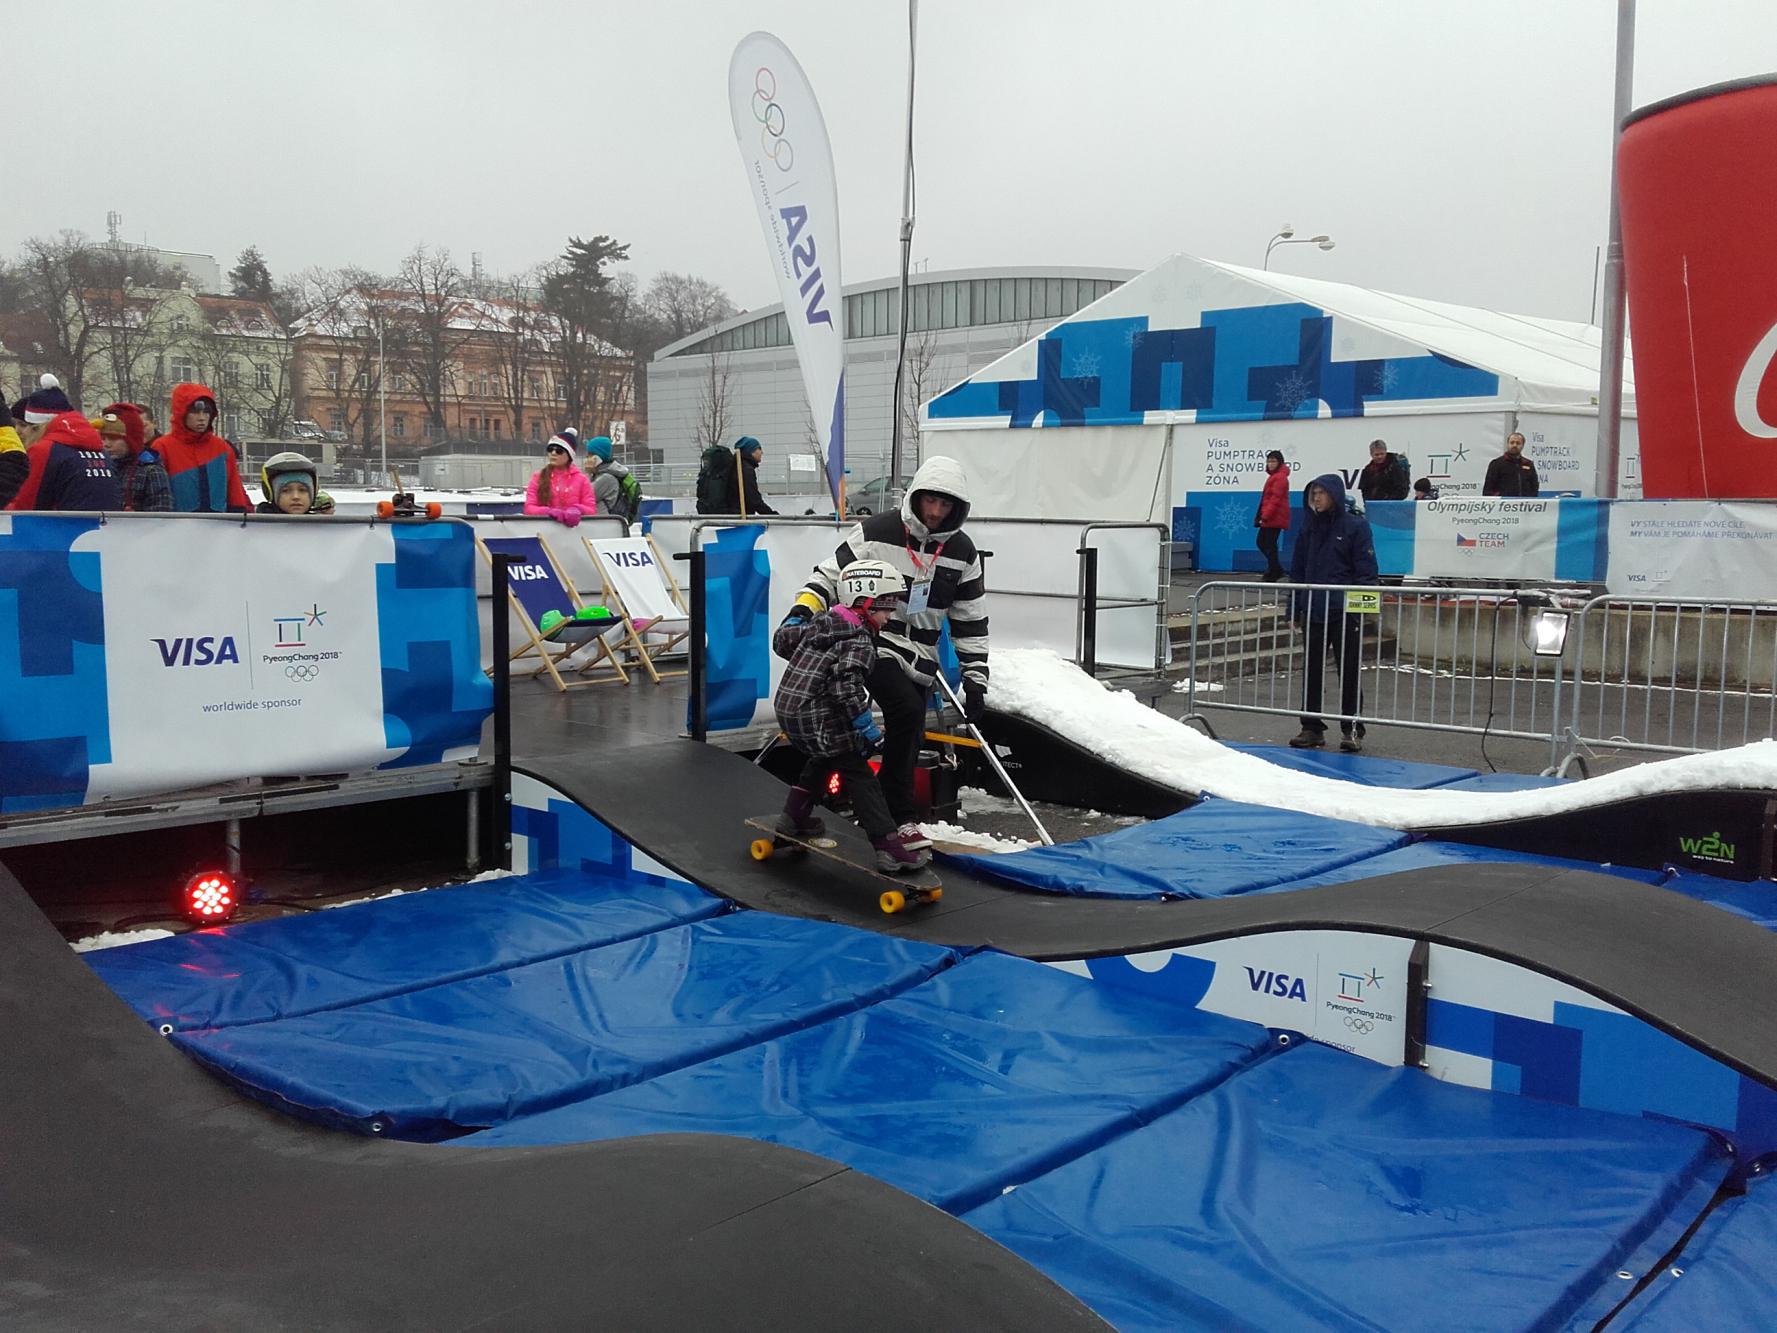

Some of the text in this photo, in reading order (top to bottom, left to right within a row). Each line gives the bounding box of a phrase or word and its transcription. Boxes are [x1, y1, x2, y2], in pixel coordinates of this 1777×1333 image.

[1207, 438, 1229, 448] Visa
[1207, 449, 1281, 460] PUMPTRA
[1531, 446, 1571, 456] PUMPTRACK
[1206, 462, 1302, 473] A SNOWBD
[1205, 473, 1240, 485] ZÓNA
[1427, 501, 1548, 514] Olympijský festival
[1452, 517, 1520, 526] PyeongChang 2018
[1478, 532, 1510, 540] CZECH
[602, 551, 654, 567] VISA
[507, 564, 549, 581] VISA
[1627, 574, 1647, 582] VISA
[847, 580, 863, 593] 13
[150, 636, 240, 667] VISA
[263, 652, 339, 664] PyeongChang 2018
[202, 698, 303, 713] worldwide sponsor
[1242, 965, 1307, 1003] VISA
[1326, 1001, 1393, 1022] PyeongChang 2018
